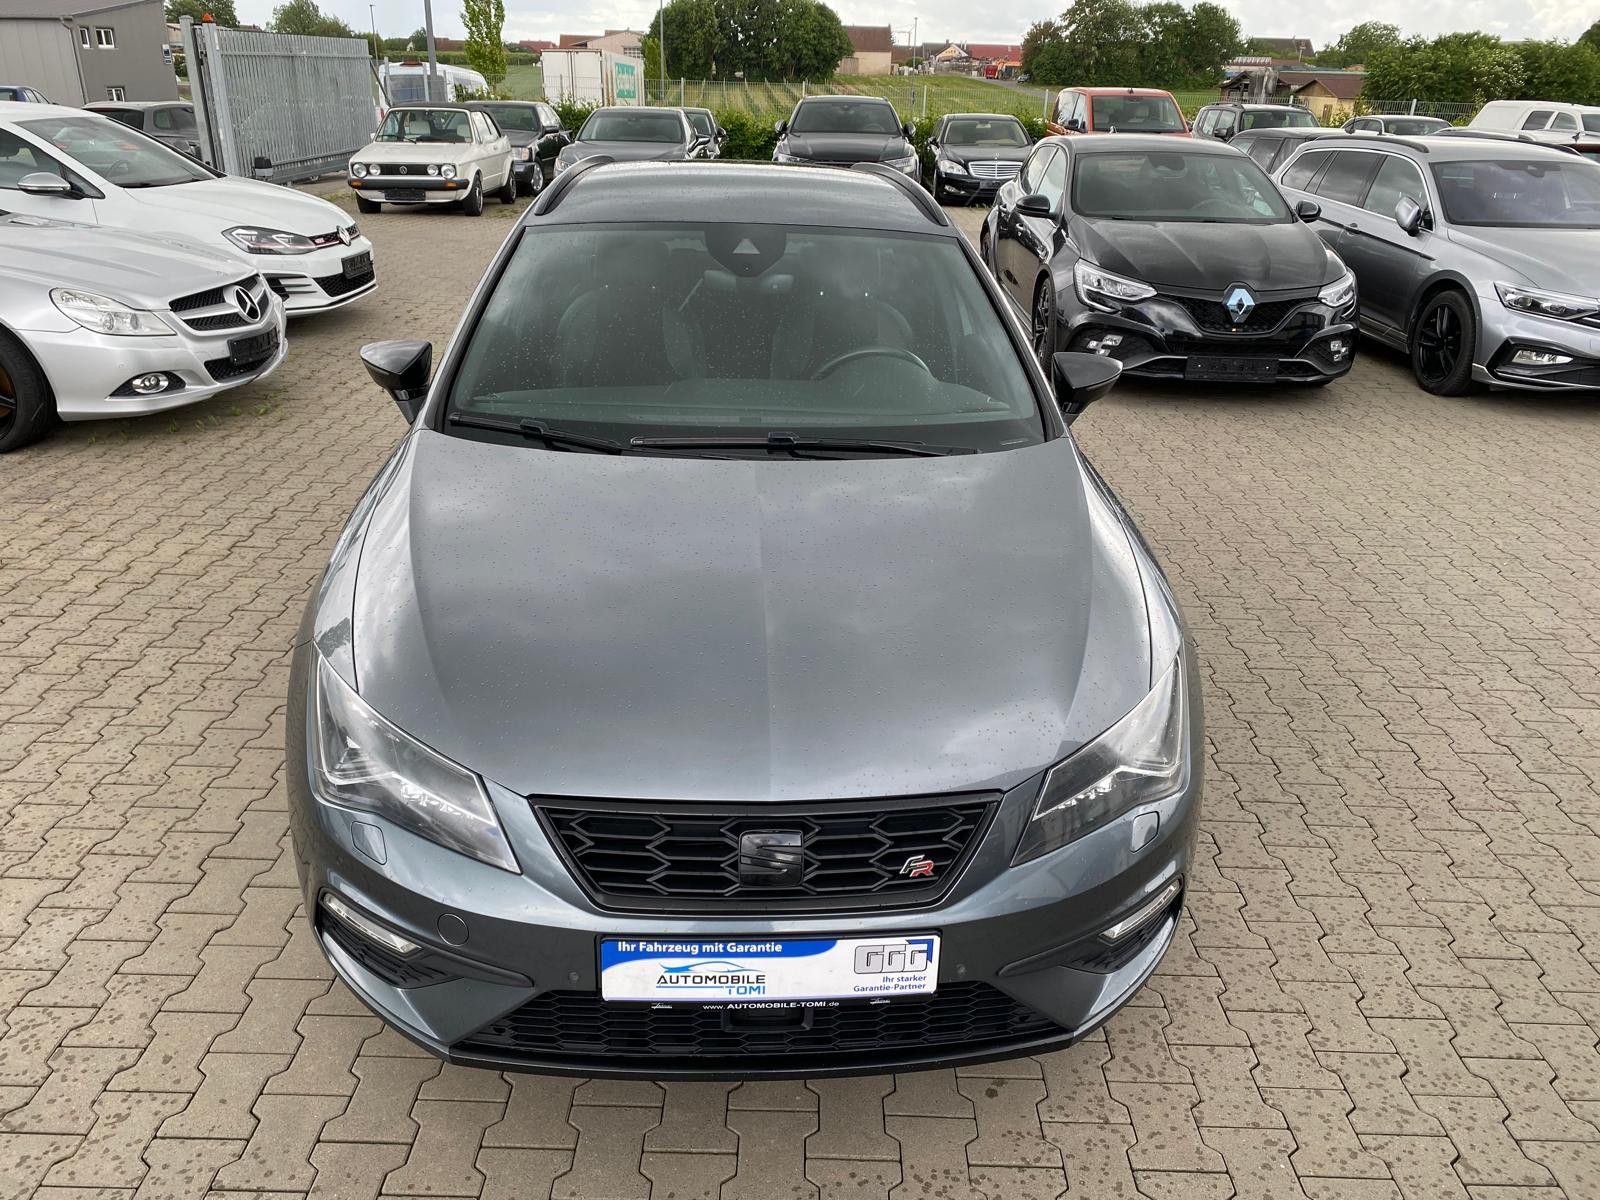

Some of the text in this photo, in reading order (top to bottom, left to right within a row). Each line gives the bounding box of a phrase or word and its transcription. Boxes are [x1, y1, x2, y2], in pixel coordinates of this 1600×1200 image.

[899, 854, 935, 877] FR
[618, 942, 783, 954] Ihr Fahrzeug mit Garantie
[854, 944, 928, 974] GGG
[656, 975, 766, 985] AUTOMOBILE
[725, 985, 766, 995] TOMI
[853, 983, 927, 992] Garantie-Partner
